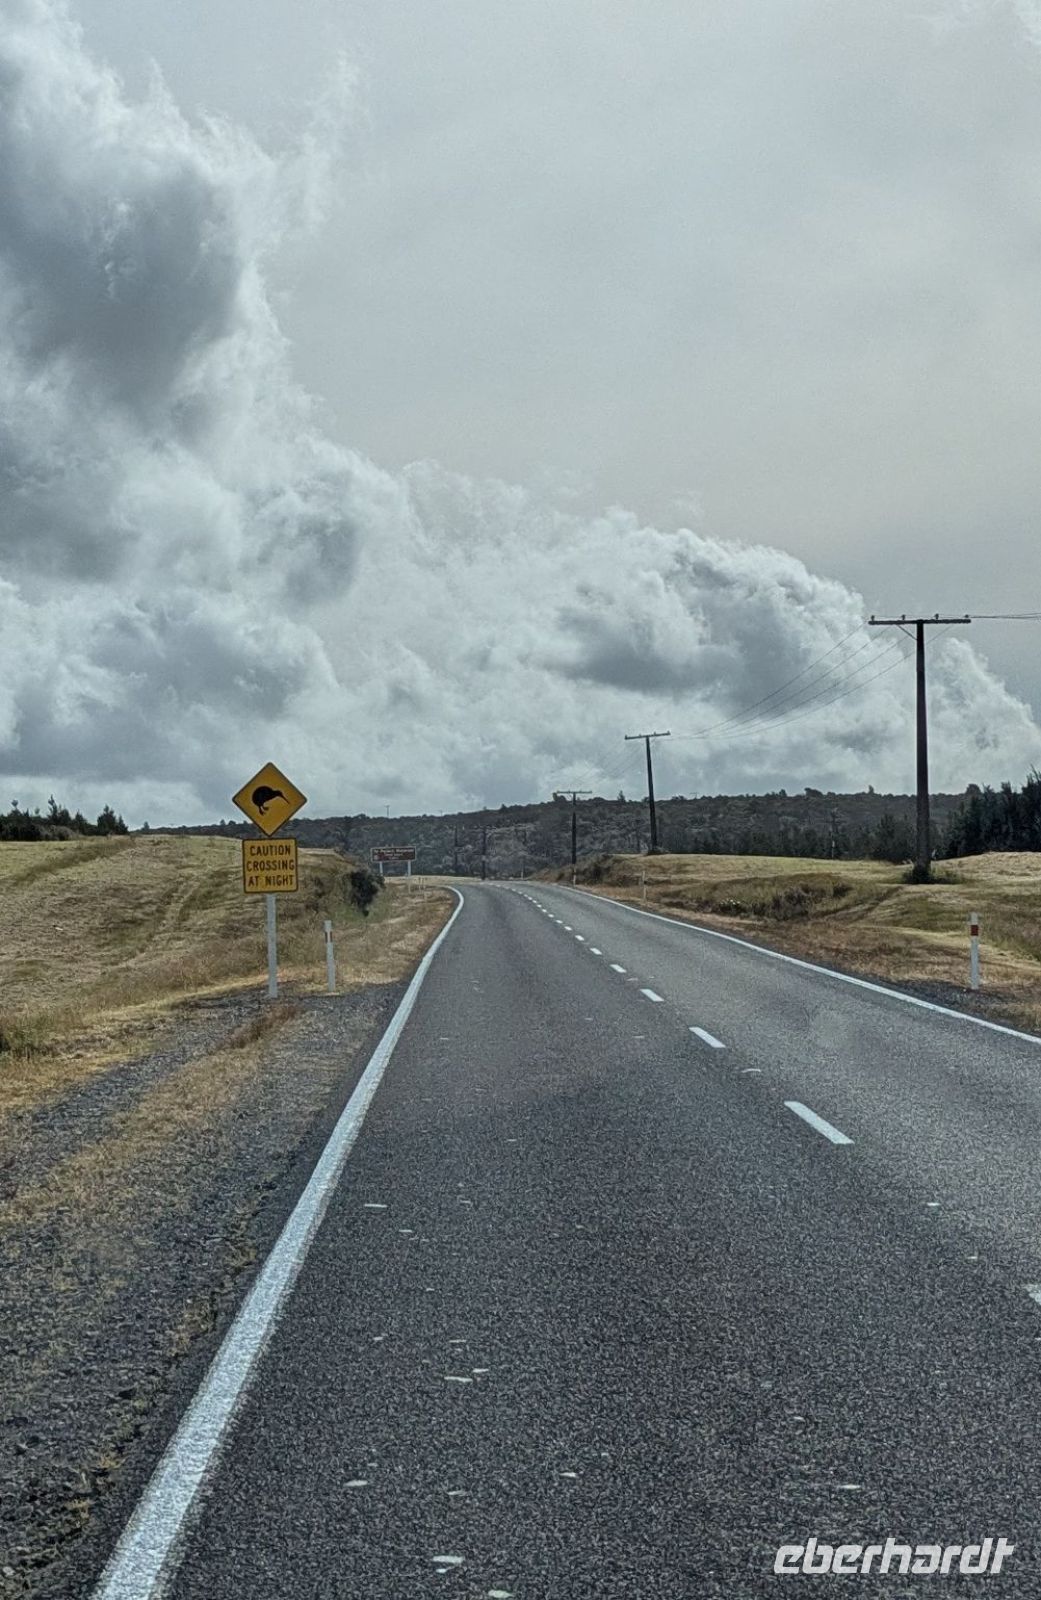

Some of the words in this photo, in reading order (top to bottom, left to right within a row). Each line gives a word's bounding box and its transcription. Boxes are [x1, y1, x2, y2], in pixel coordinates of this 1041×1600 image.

[250, 844, 291, 857] CAUTION
[246, 859, 295, 872] CROSSING
[248, 875, 260, 887] AT
[265, 874, 294, 886] NIGHT
